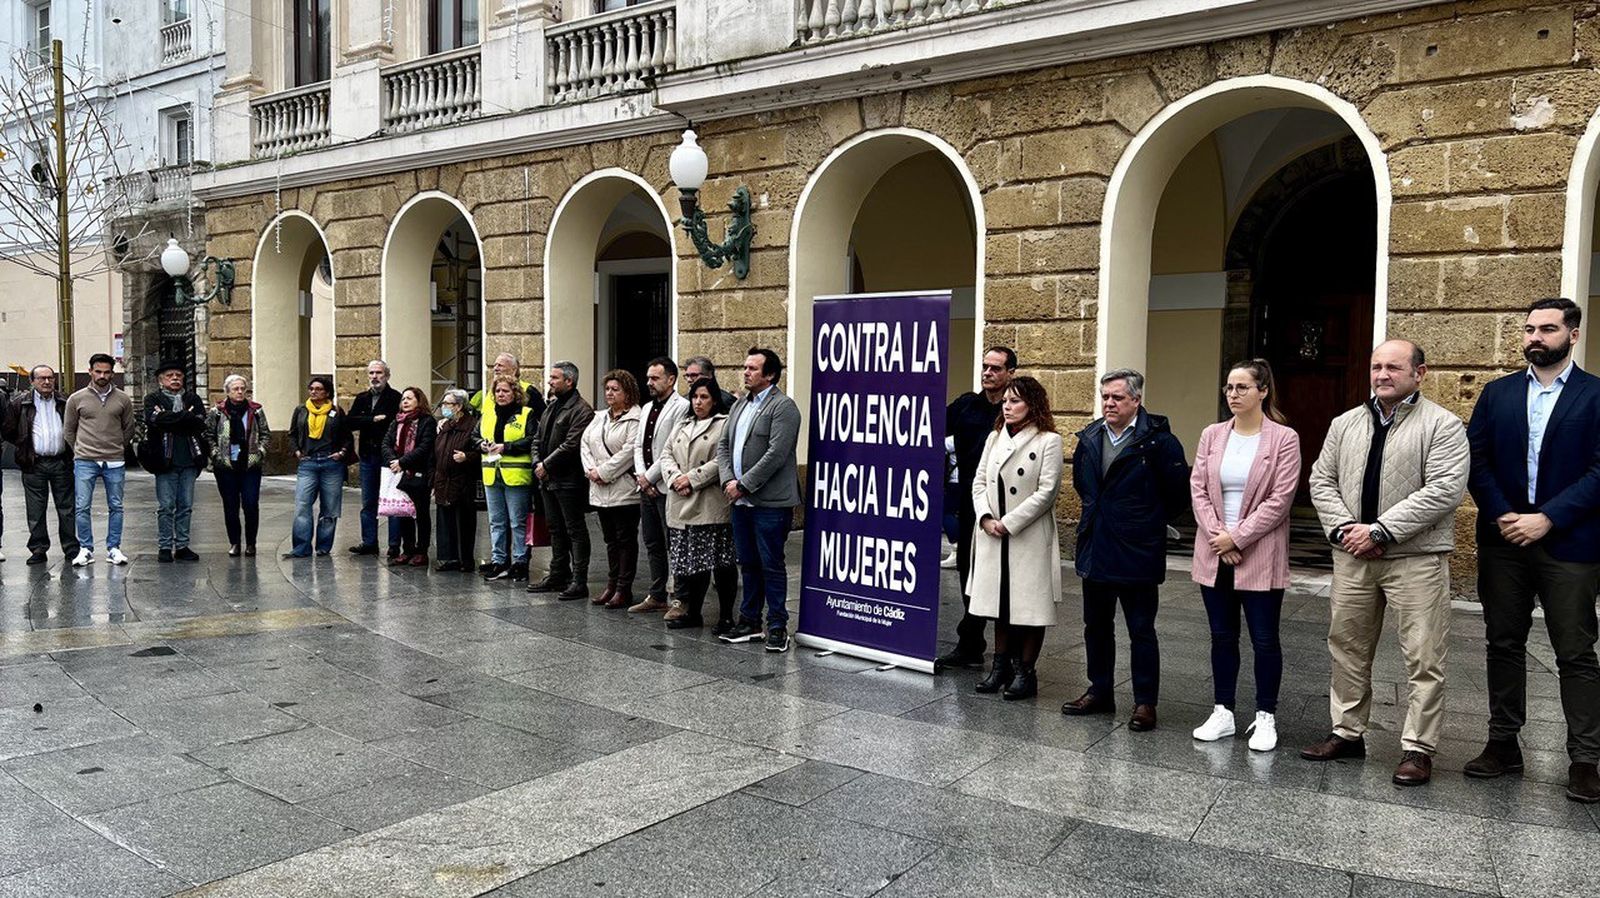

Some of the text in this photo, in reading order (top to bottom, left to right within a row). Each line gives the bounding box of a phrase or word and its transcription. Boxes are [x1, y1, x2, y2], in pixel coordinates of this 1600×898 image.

[817, 320, 940, 373] CONTRA LA
[818, 392, 933, 448] VIOLENCIA
[814, 461, 929, 522] HACIA LAS
[820, 530, 916, 594] MUJERES
[826, 595, 906, 620] Ayuntamiento de Cádiz
